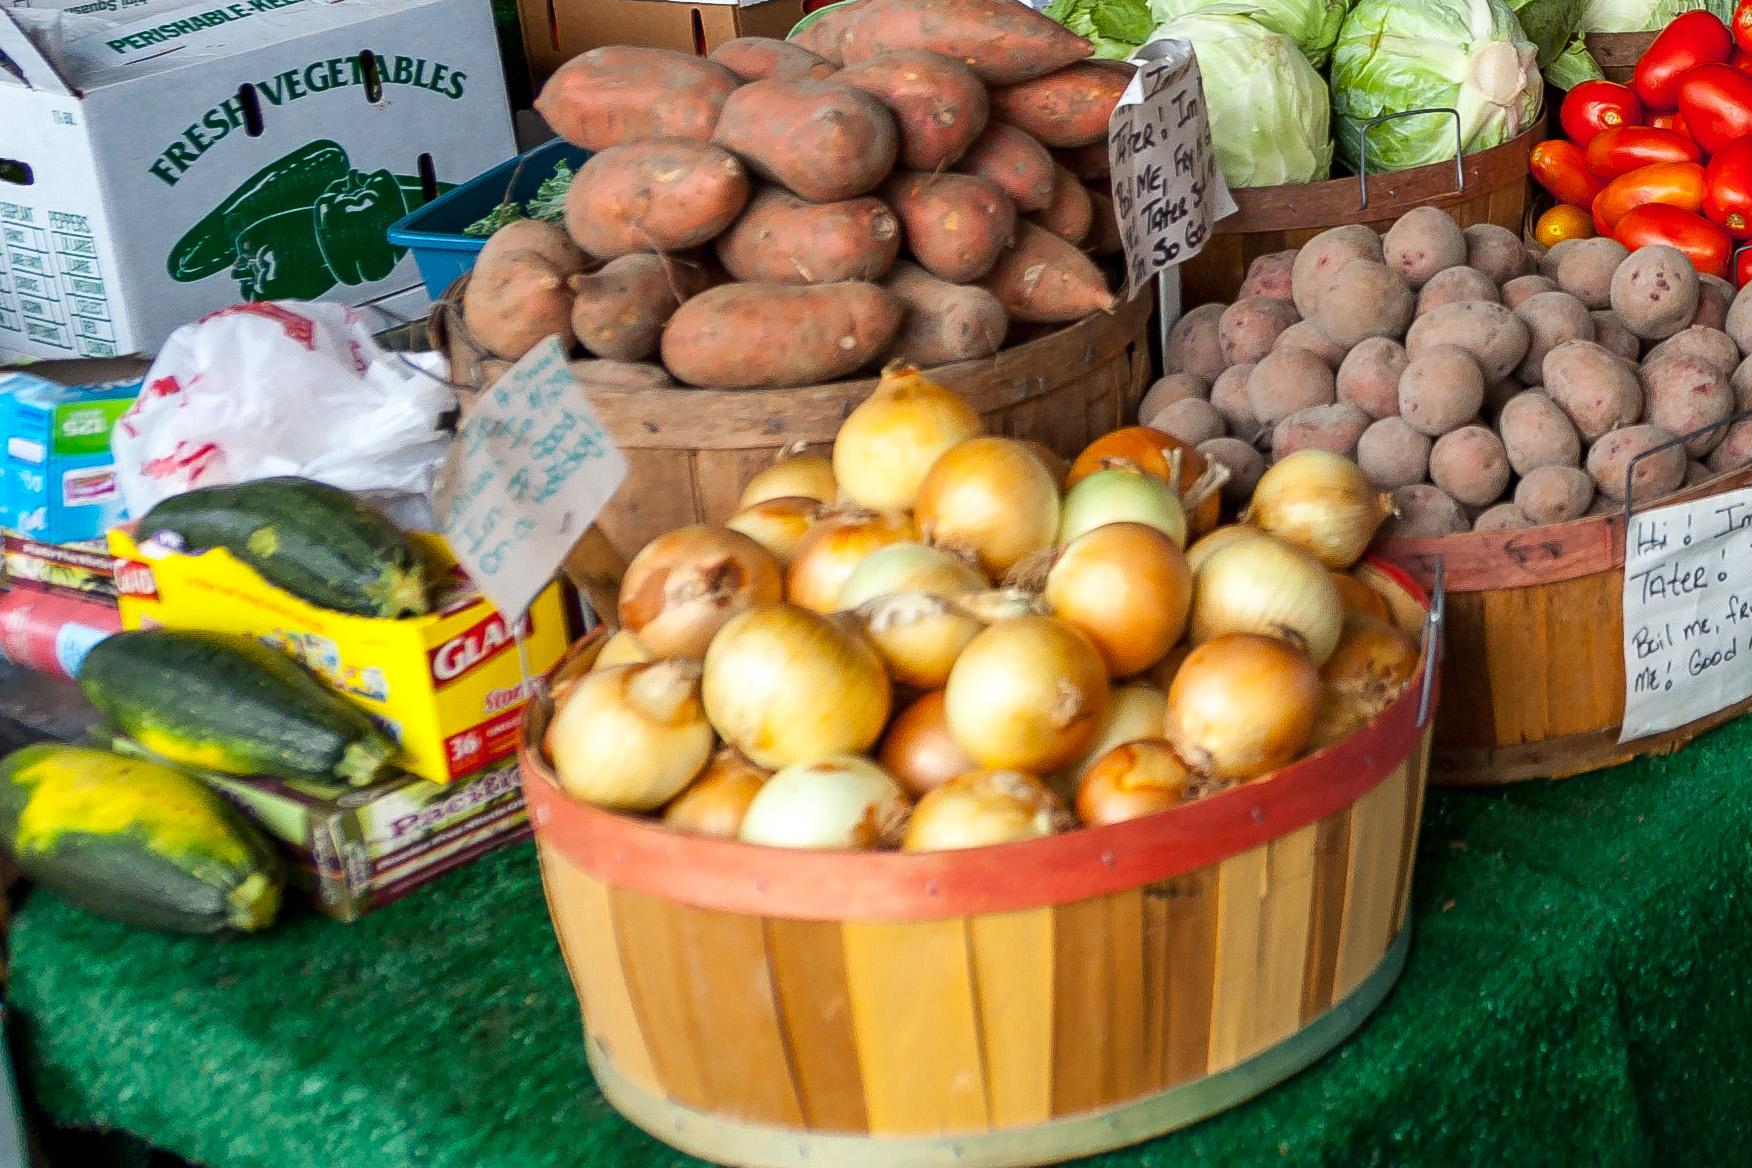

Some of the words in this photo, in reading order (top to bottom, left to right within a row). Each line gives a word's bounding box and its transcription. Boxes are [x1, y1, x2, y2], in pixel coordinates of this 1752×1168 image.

[63, 0, 118, 15] Squas
[148, 94, 246, 188] FRESH
[254, 54, 469, 106] VEGETABLES
[433, 619, 525, 681] GLA
[1689, 638, 1737, 677] Good
